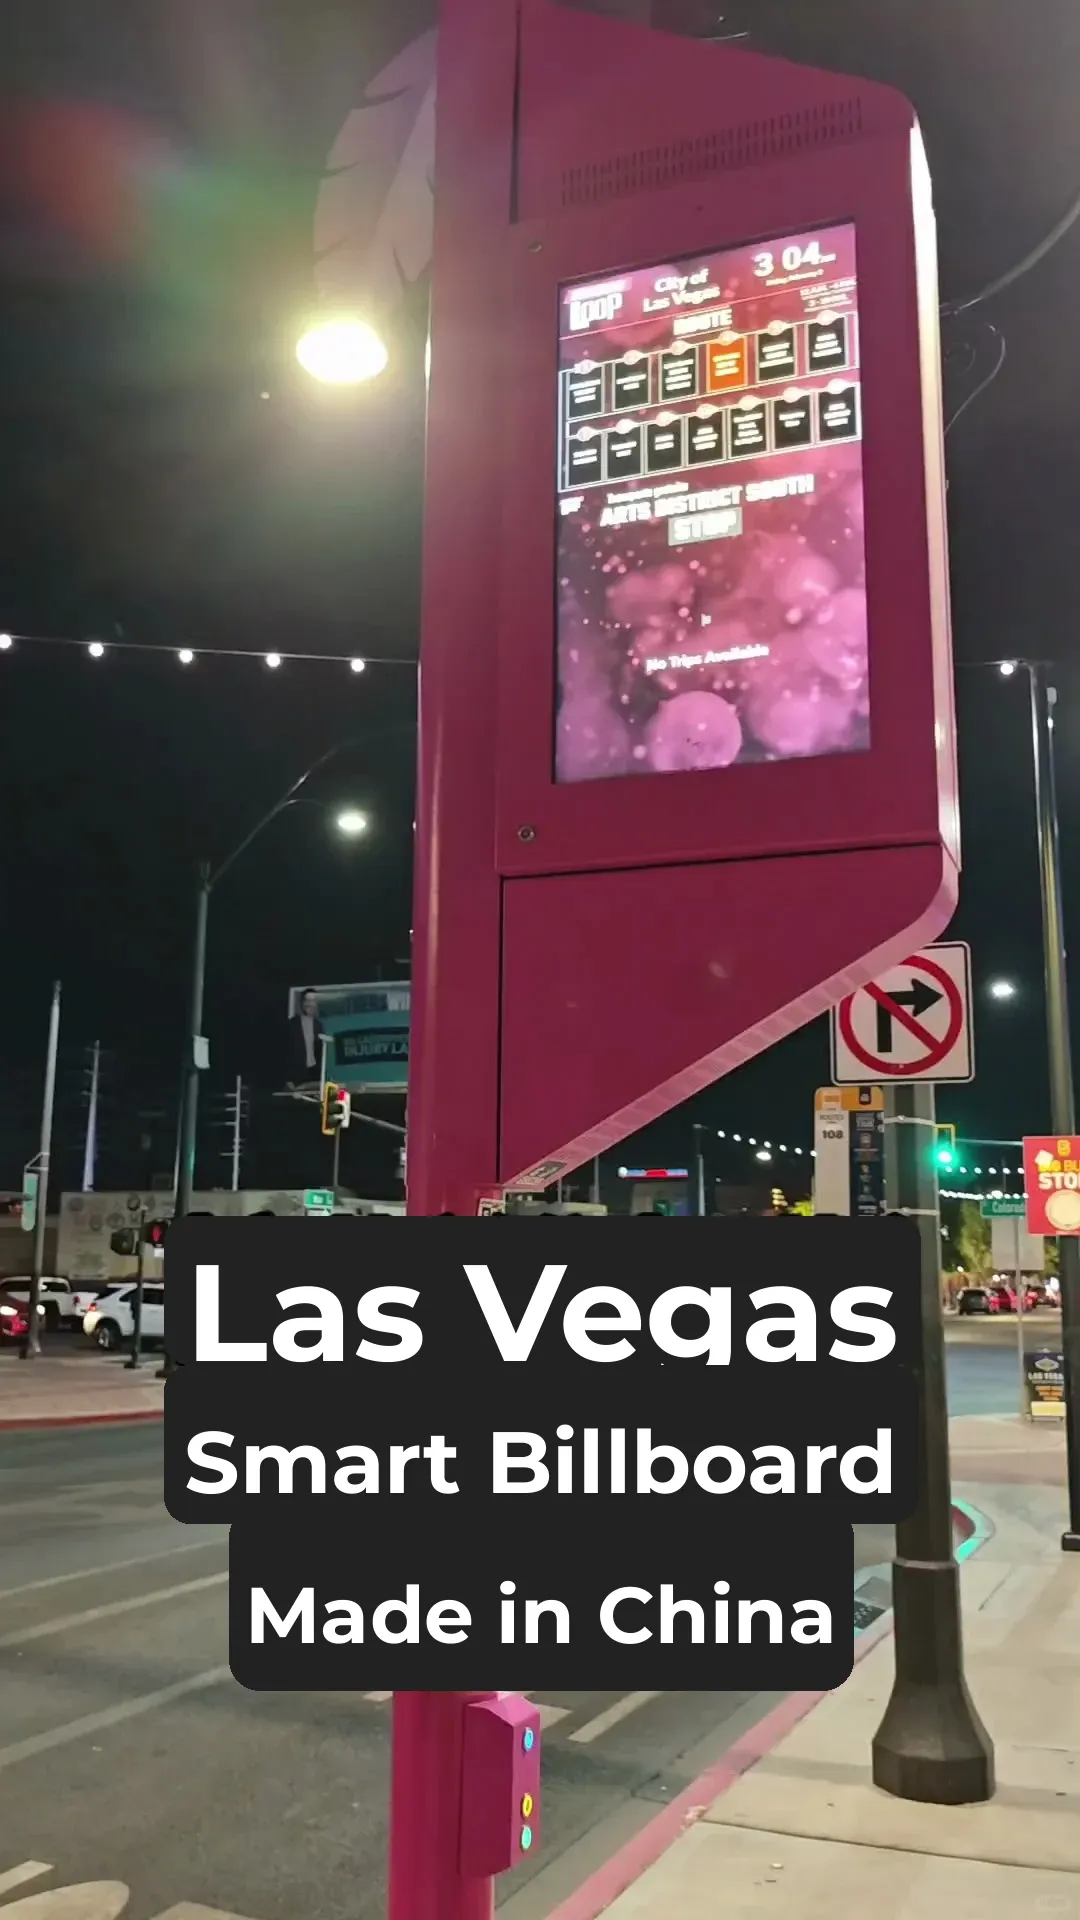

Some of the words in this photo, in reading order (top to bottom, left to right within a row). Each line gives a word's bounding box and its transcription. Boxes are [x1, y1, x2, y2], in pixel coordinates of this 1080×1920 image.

[654, 276, 687, 292] City
[690, 269, 709, 284] of
[643, 297, 670, 312] Las
[671, 286, 720, 305] Vegas
[600, 502, 651, 527] ARTS
[745, 474, 814, 502] SOUTH
[674, 510, 737, 541] STOP
[646, 657, 667, 671] No
[668, 654, 702, 669] Trips
[704, 643, 769, 664] Available
[822, 1129, 844, 1139] 108
[1038, 1172, 1080, 1190] STO
